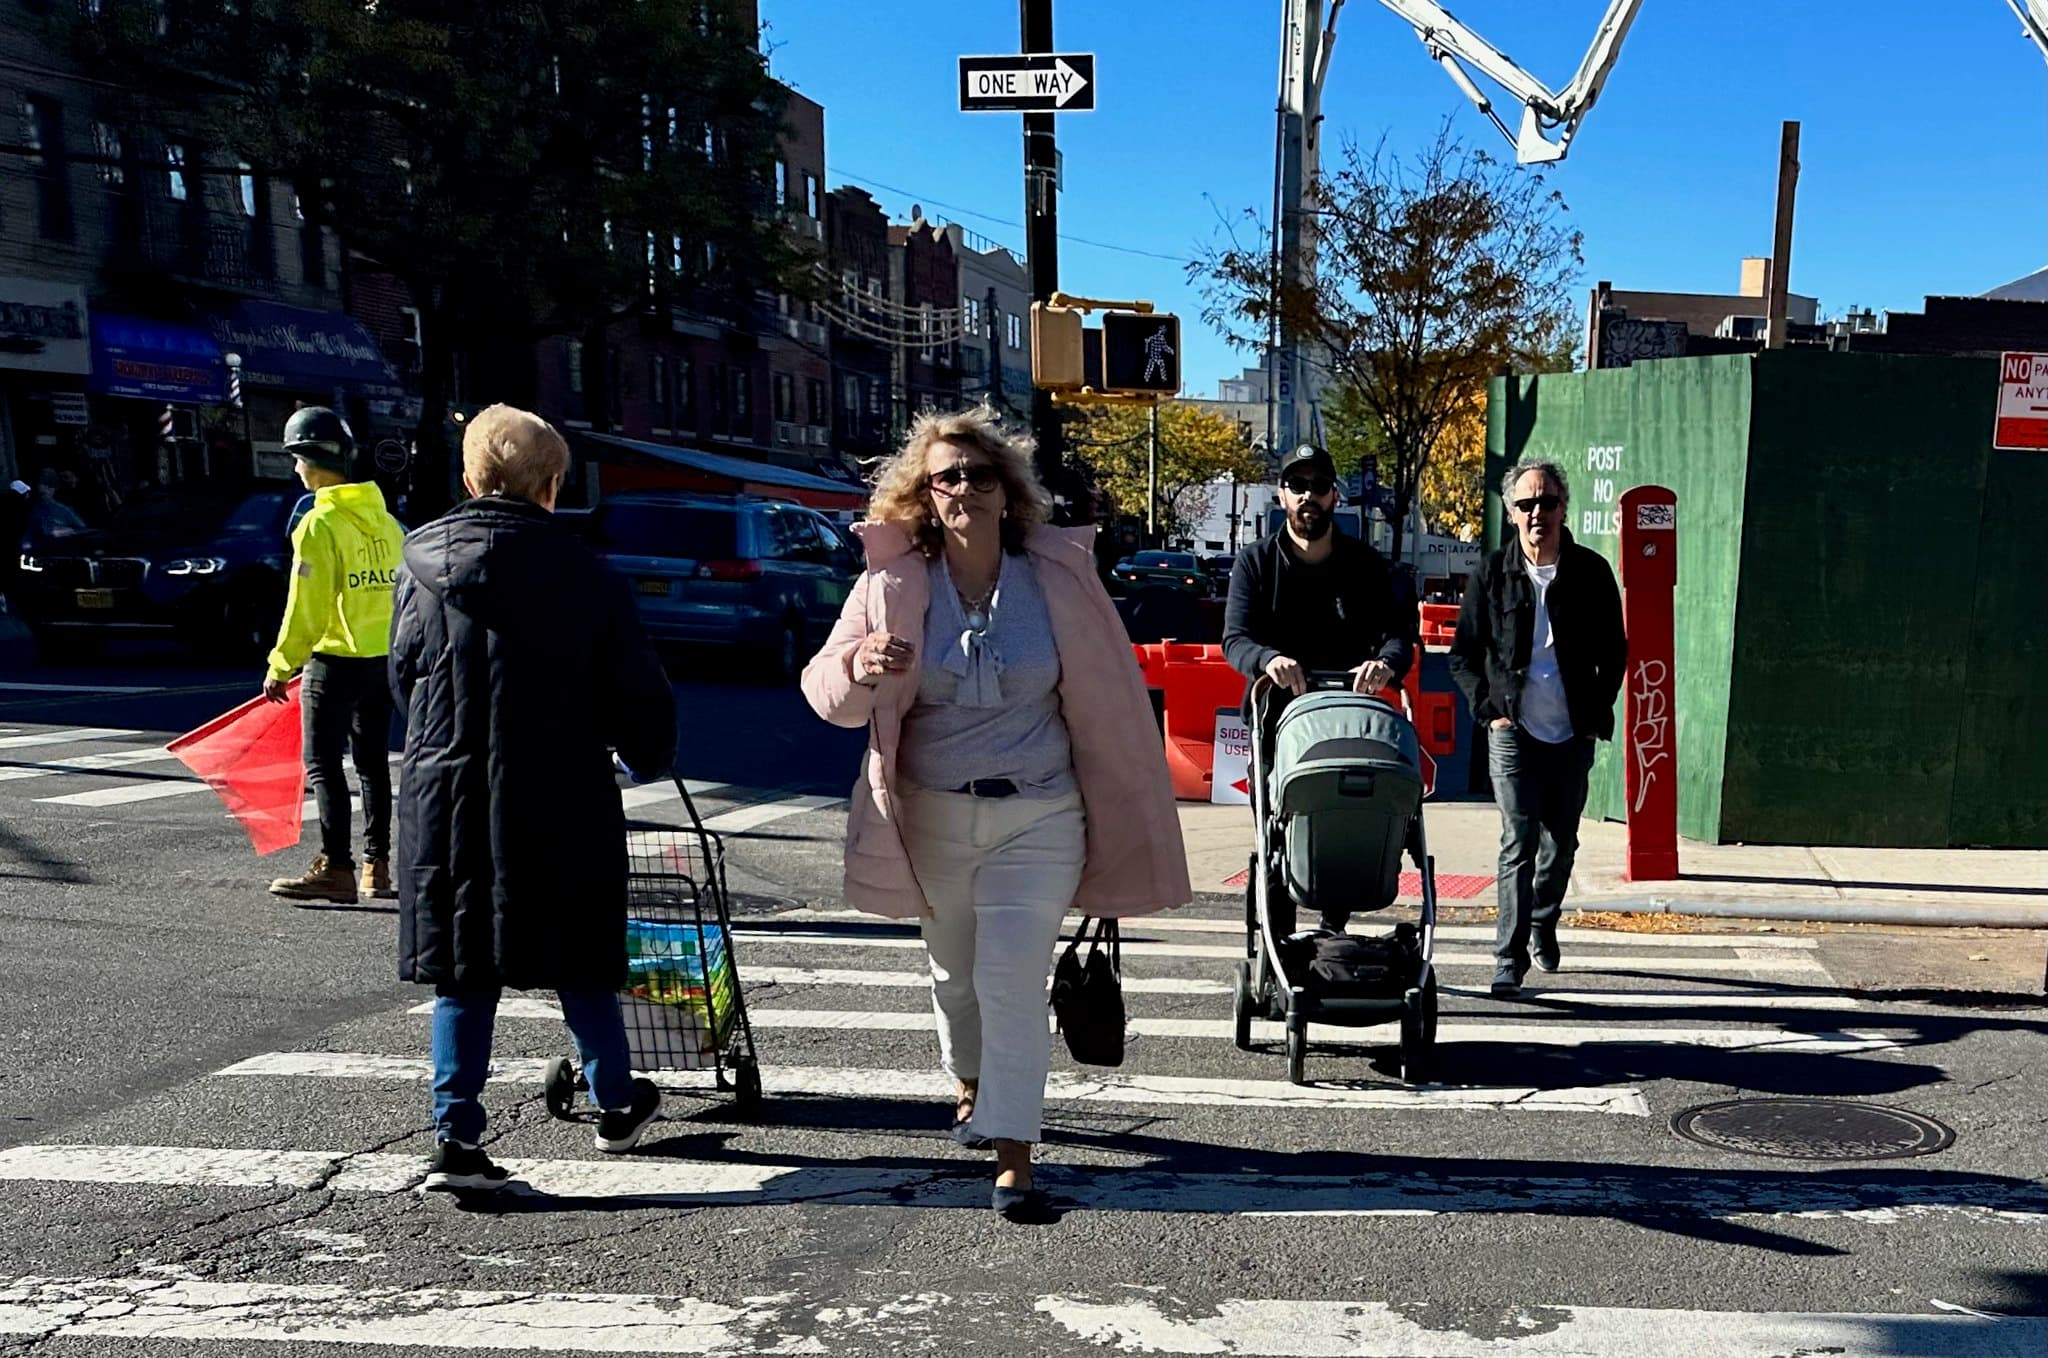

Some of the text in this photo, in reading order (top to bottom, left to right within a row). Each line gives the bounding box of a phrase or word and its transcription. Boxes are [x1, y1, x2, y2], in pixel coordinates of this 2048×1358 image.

[978, 73, 1073, 94] ONE WAY
[2005, 358, 2030, 379] NO
[1587, 446, 1623, 471] POST
[1593, 478, 1613, 503] NO
[1583, 510, 1621, 536] BILLS
[1219, 727, 1249, 741] SIDE
[1224, 742, 1250, 757] USE
